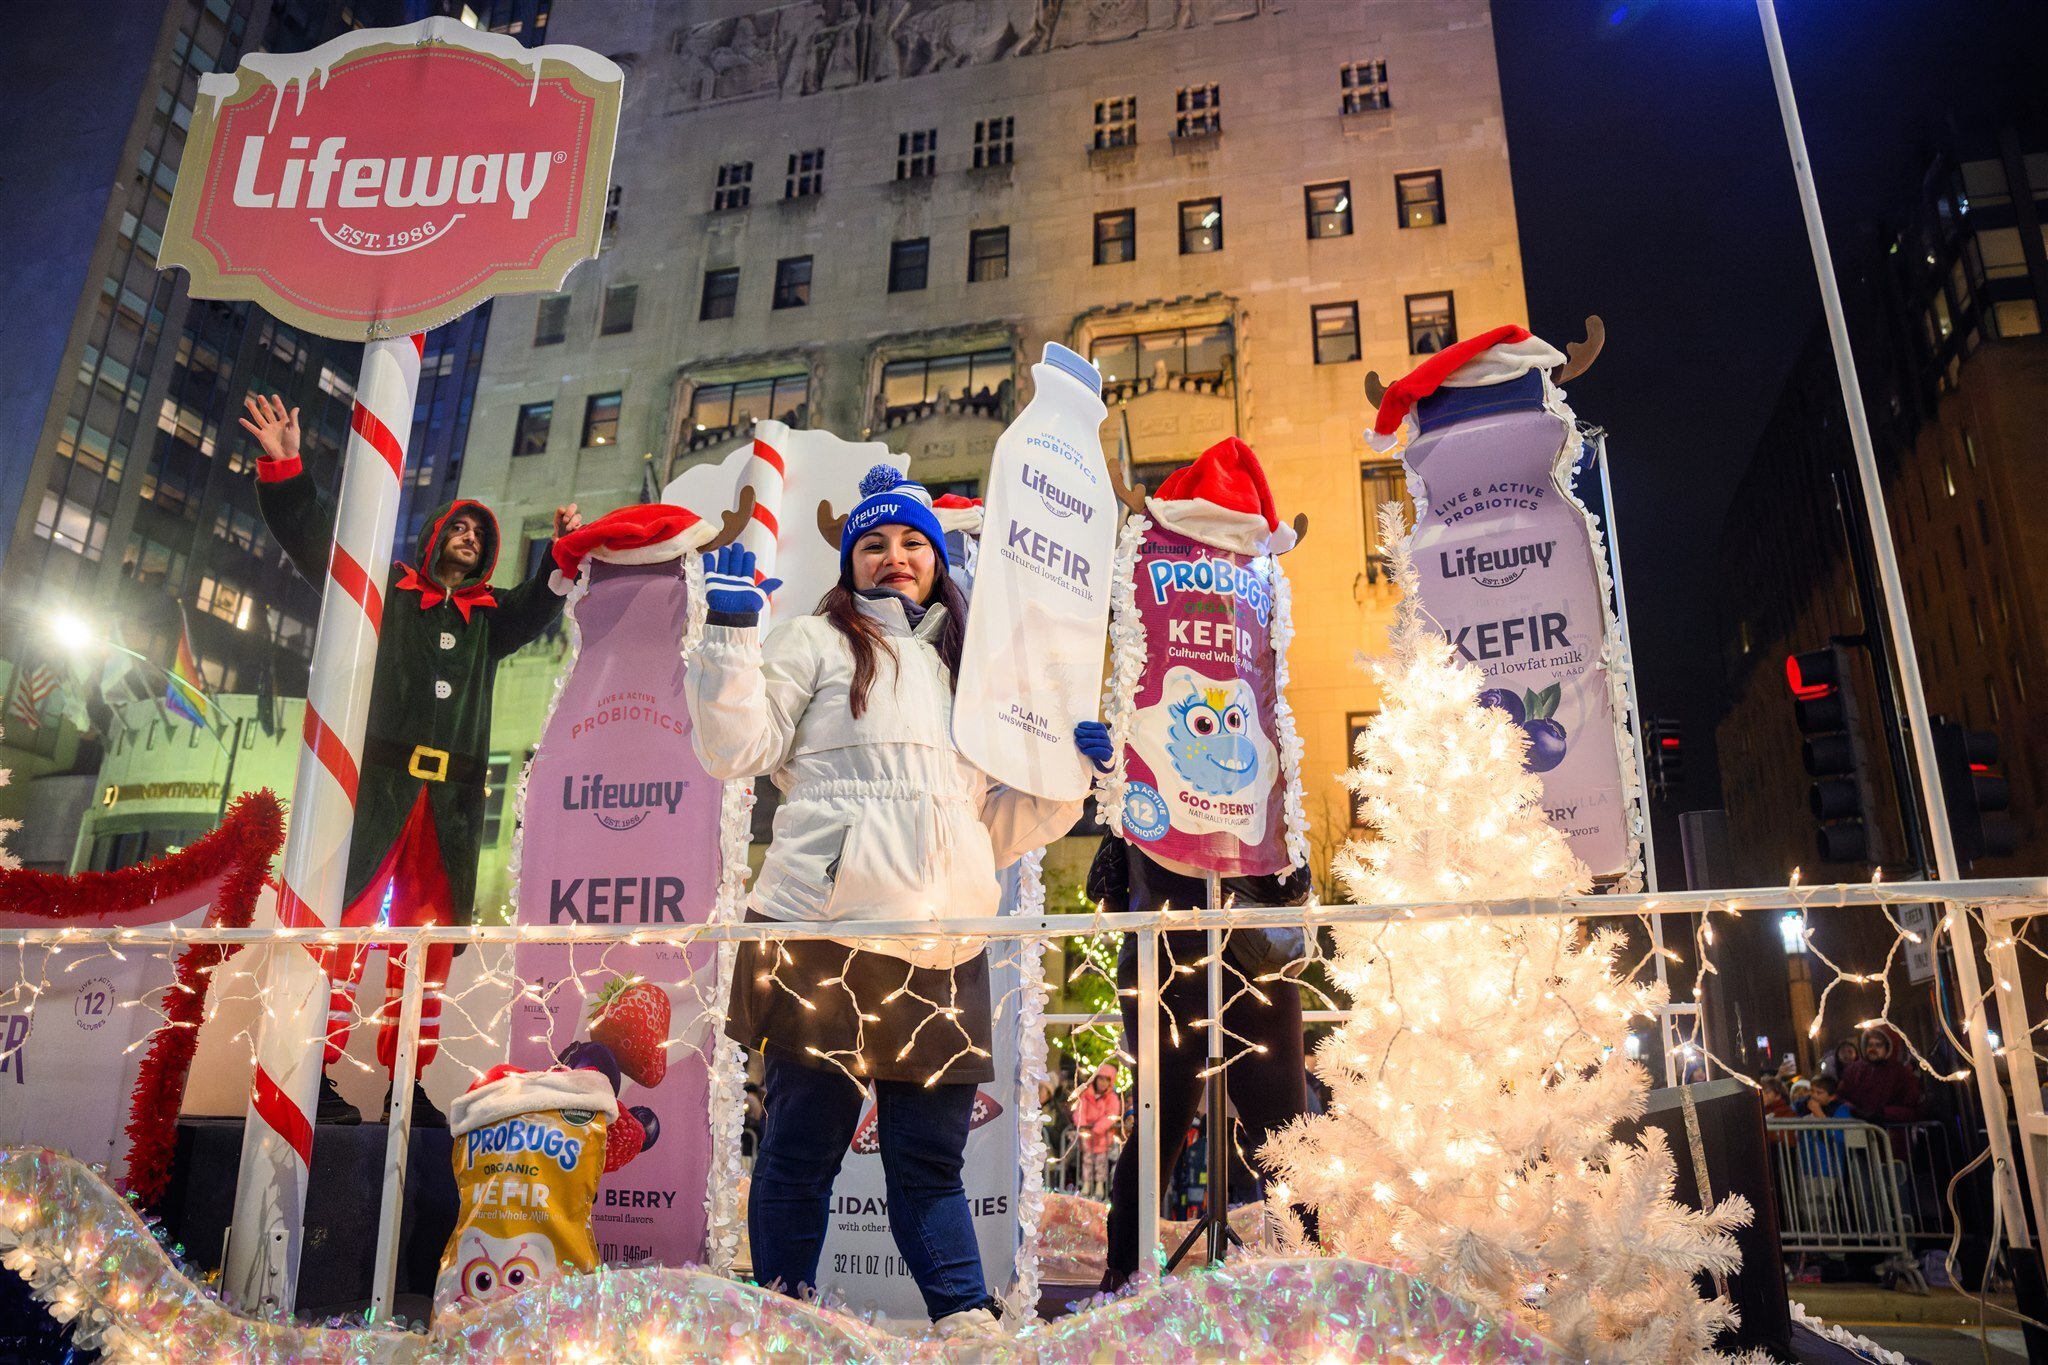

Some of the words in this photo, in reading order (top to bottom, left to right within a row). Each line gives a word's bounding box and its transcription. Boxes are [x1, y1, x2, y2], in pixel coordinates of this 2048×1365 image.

[334, 223, 381, 248] EST.
[386, 220, 436, 247] 1986
[1027, 437, 1096, 484] PROBIOTICS
[1434, 493, 1468, 517] LIVE
[1473, 487, 1482, 497] &
[1488, 483, 1544, 498] ACTIVE
[1444, 498, 1538, 527] PROBIOTICS
[847, 503, 899, 534] Lifeway
[1008, 519, 1090, 587] KEFIR
[1140, 542, 1193, 557] Lifeway
[1000, 548, 1040, 573] cultured
[1041, 568, 1070, 590] lowfat
[1071, 585, 1093, 602] milk
[1482, 577, 1500, 586] EST.
[1501, 572, 1518, 584] 1986
[1168, 619, 1253, 659] KEFIR
[1445, 612, 1571, 662] KEFIR
[1168, 646, 1212, 661] Cultured
[1501, 657, 1547, 675] lowfat
[1550, 651, 1583, 667] milk
[597, 694, 616, 707] LIVE
[627, 692, 656, 704] ACTIVE
[572, 706, 682, 739] PROBIOTICS
[1011, 704, 1048, 729] PLAIN
[1130, 800, 1154, 823] 12
[1134, 784, 1139, 792] &
[1141, 786, 1167, 816] ACTIVE
[1122, 811, 1165, 837] PROBIOTICS
[1188, 808, 1224, 823] NATURALLY
[549, 876, 685, 924] KEFIR
[84, 991, 106, 1015] 12
[484, 1162, 539, 1177] ORGANIC
[472, 1181, 550, 1208] KEFIR
[605, 1189, 676, 1209] BERRY
[499, 1209, 528, 1221] Whole
[595, 1213, 624, 1222] natural
[625, 1213, 654, 1224] flavors
[838, 1221, 860, 1231] with
[861, 1222, 886, 1232] other
[834, 1254, 847, 1274] 32
[850, 1254, 862, 1274] FL
[865, 1255, 879, 1275] OZ
[885, 1255, 894, 1278] (1
